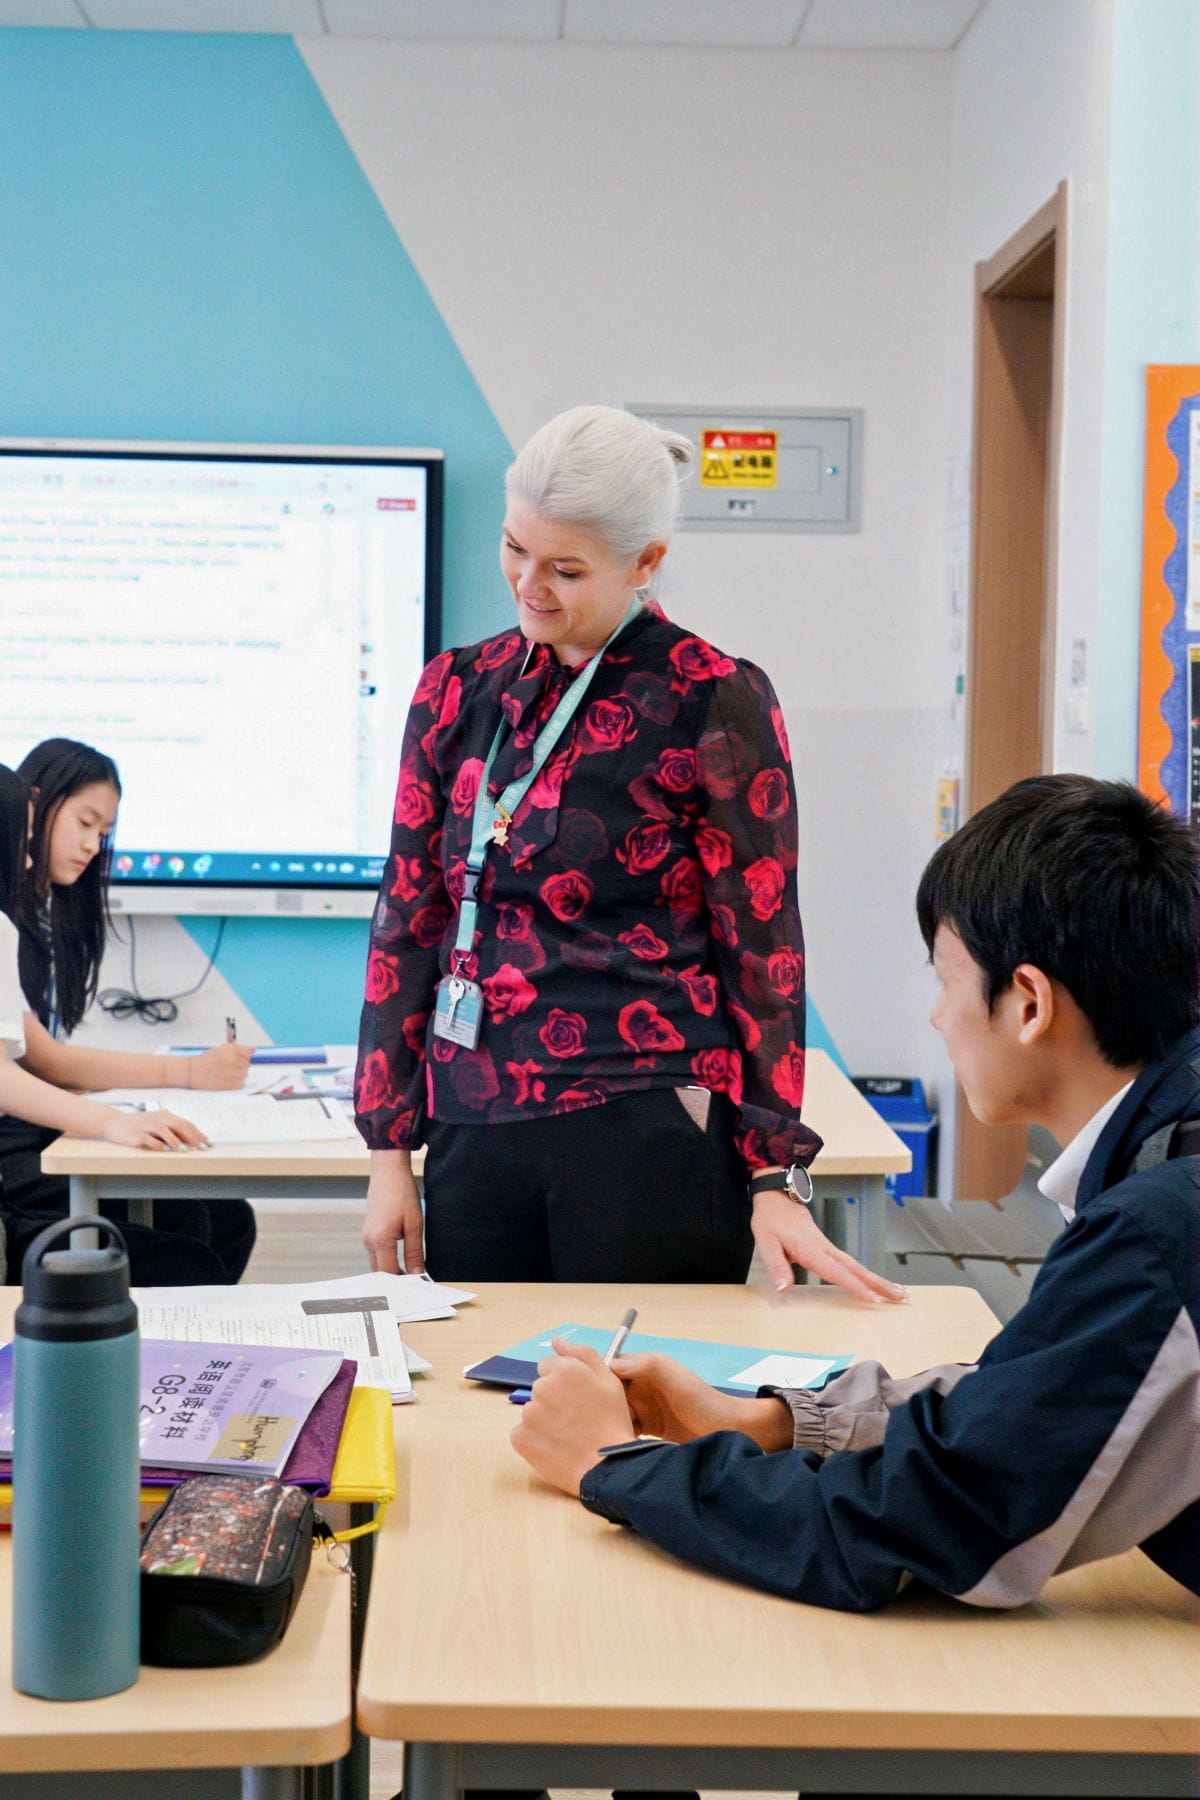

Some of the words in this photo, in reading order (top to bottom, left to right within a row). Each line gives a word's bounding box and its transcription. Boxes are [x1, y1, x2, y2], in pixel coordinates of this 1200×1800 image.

[139, 1374, 186, 1415] G8-2
[160, 1359, 231, 1439] 英语阅读材料
